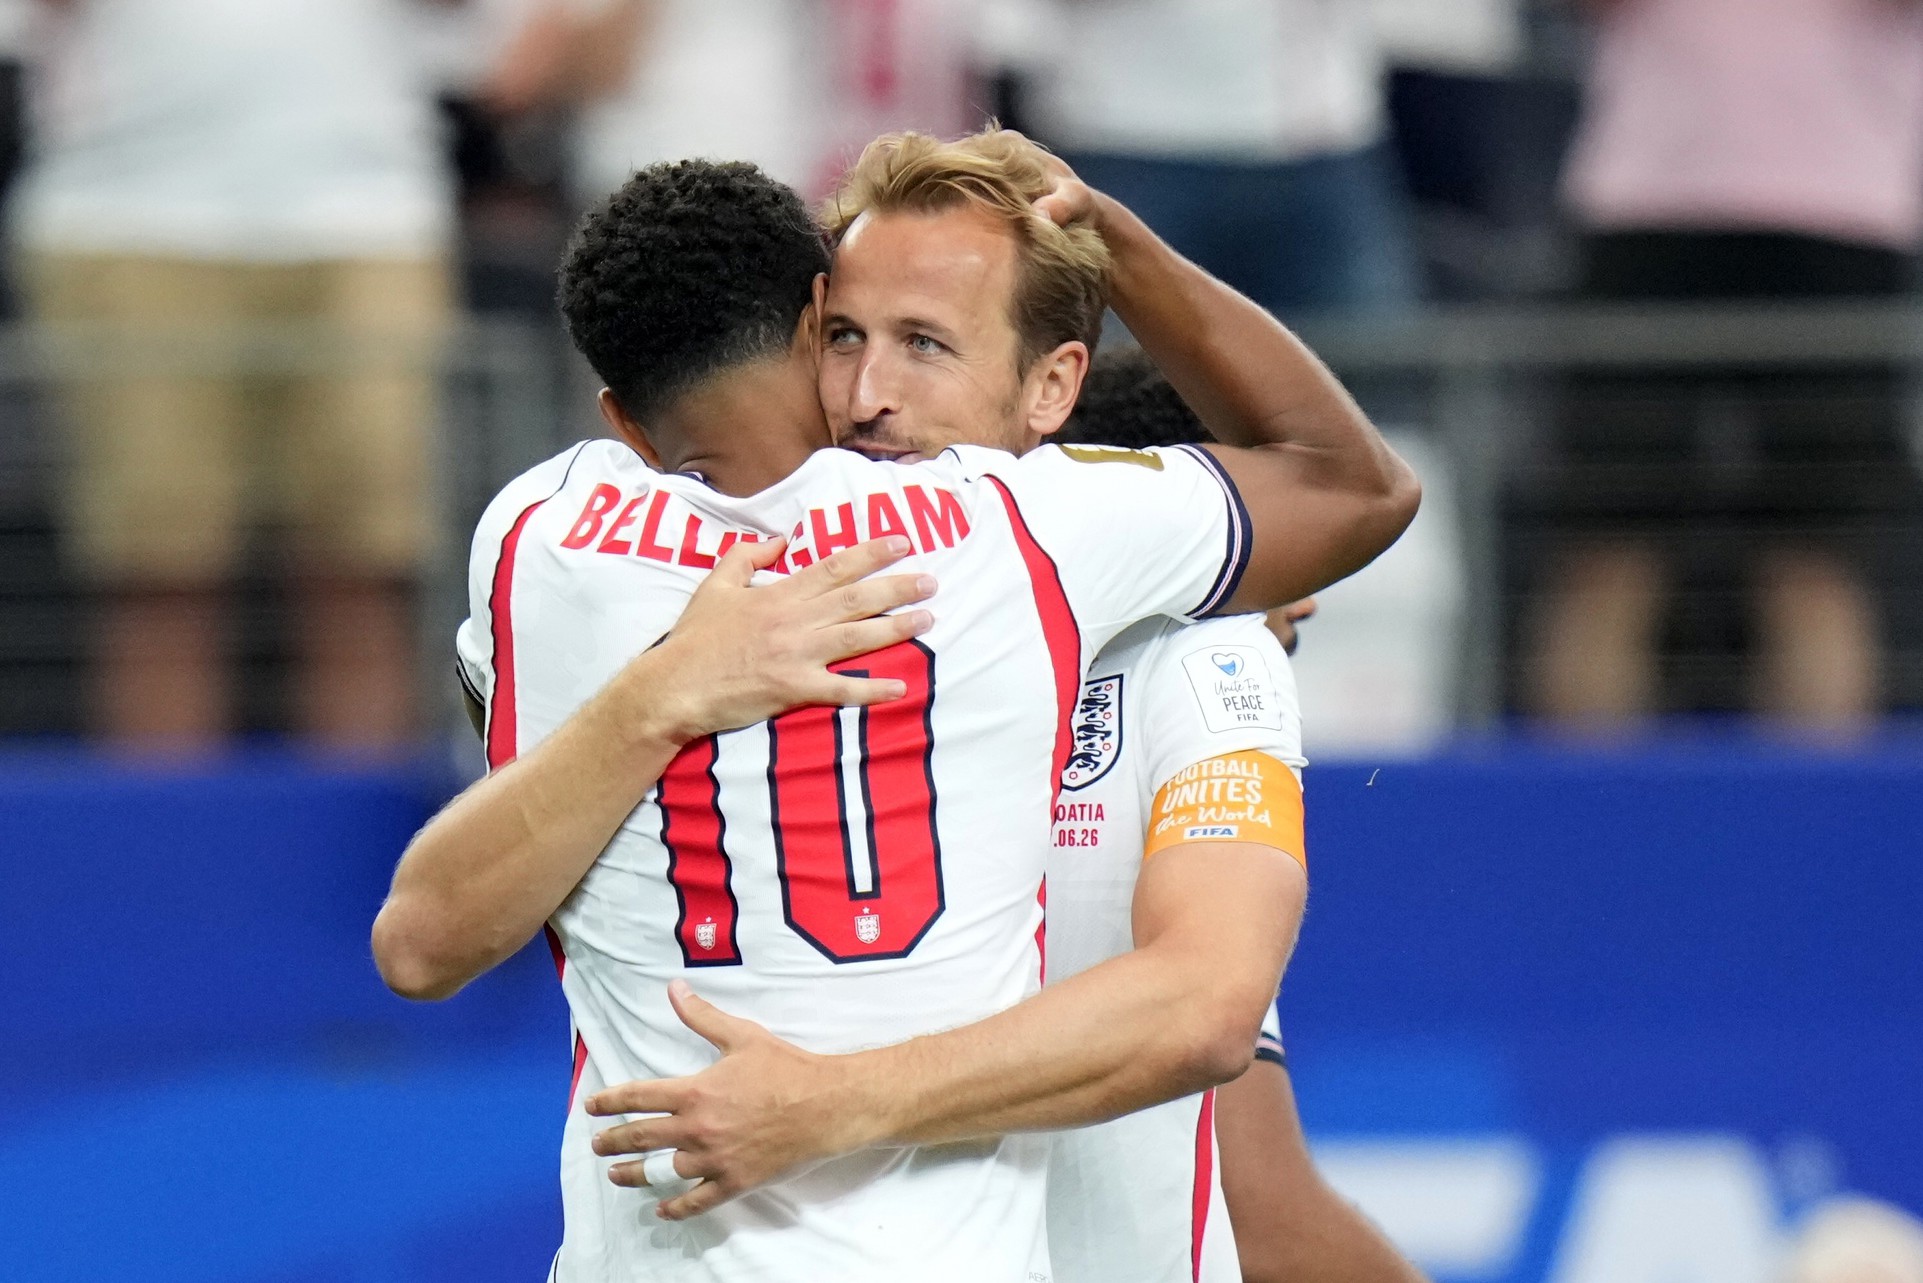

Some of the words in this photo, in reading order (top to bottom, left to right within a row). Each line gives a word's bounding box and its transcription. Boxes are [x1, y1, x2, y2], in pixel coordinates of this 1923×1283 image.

[560, 483, 971, 575] BELLIGHAM
[1214, 679, 1244, 696] Unite
[1243, 677, 1260, 692] For
[1222, 694, 1265, 712] PEACE
[1236, 713, 1260, 722] FIFA
[653, 637, 946, 968] 10
[1161, 777, 1263, 814] UNITES
[1056, 803, 1105, 822] OATIA
[1155, 812, 1193, 837] the
[1197, 804, 1272, 829] World
[1053, 828, 1098, 847] .06.26
[1188, 827, 1235, 837] FIFA
